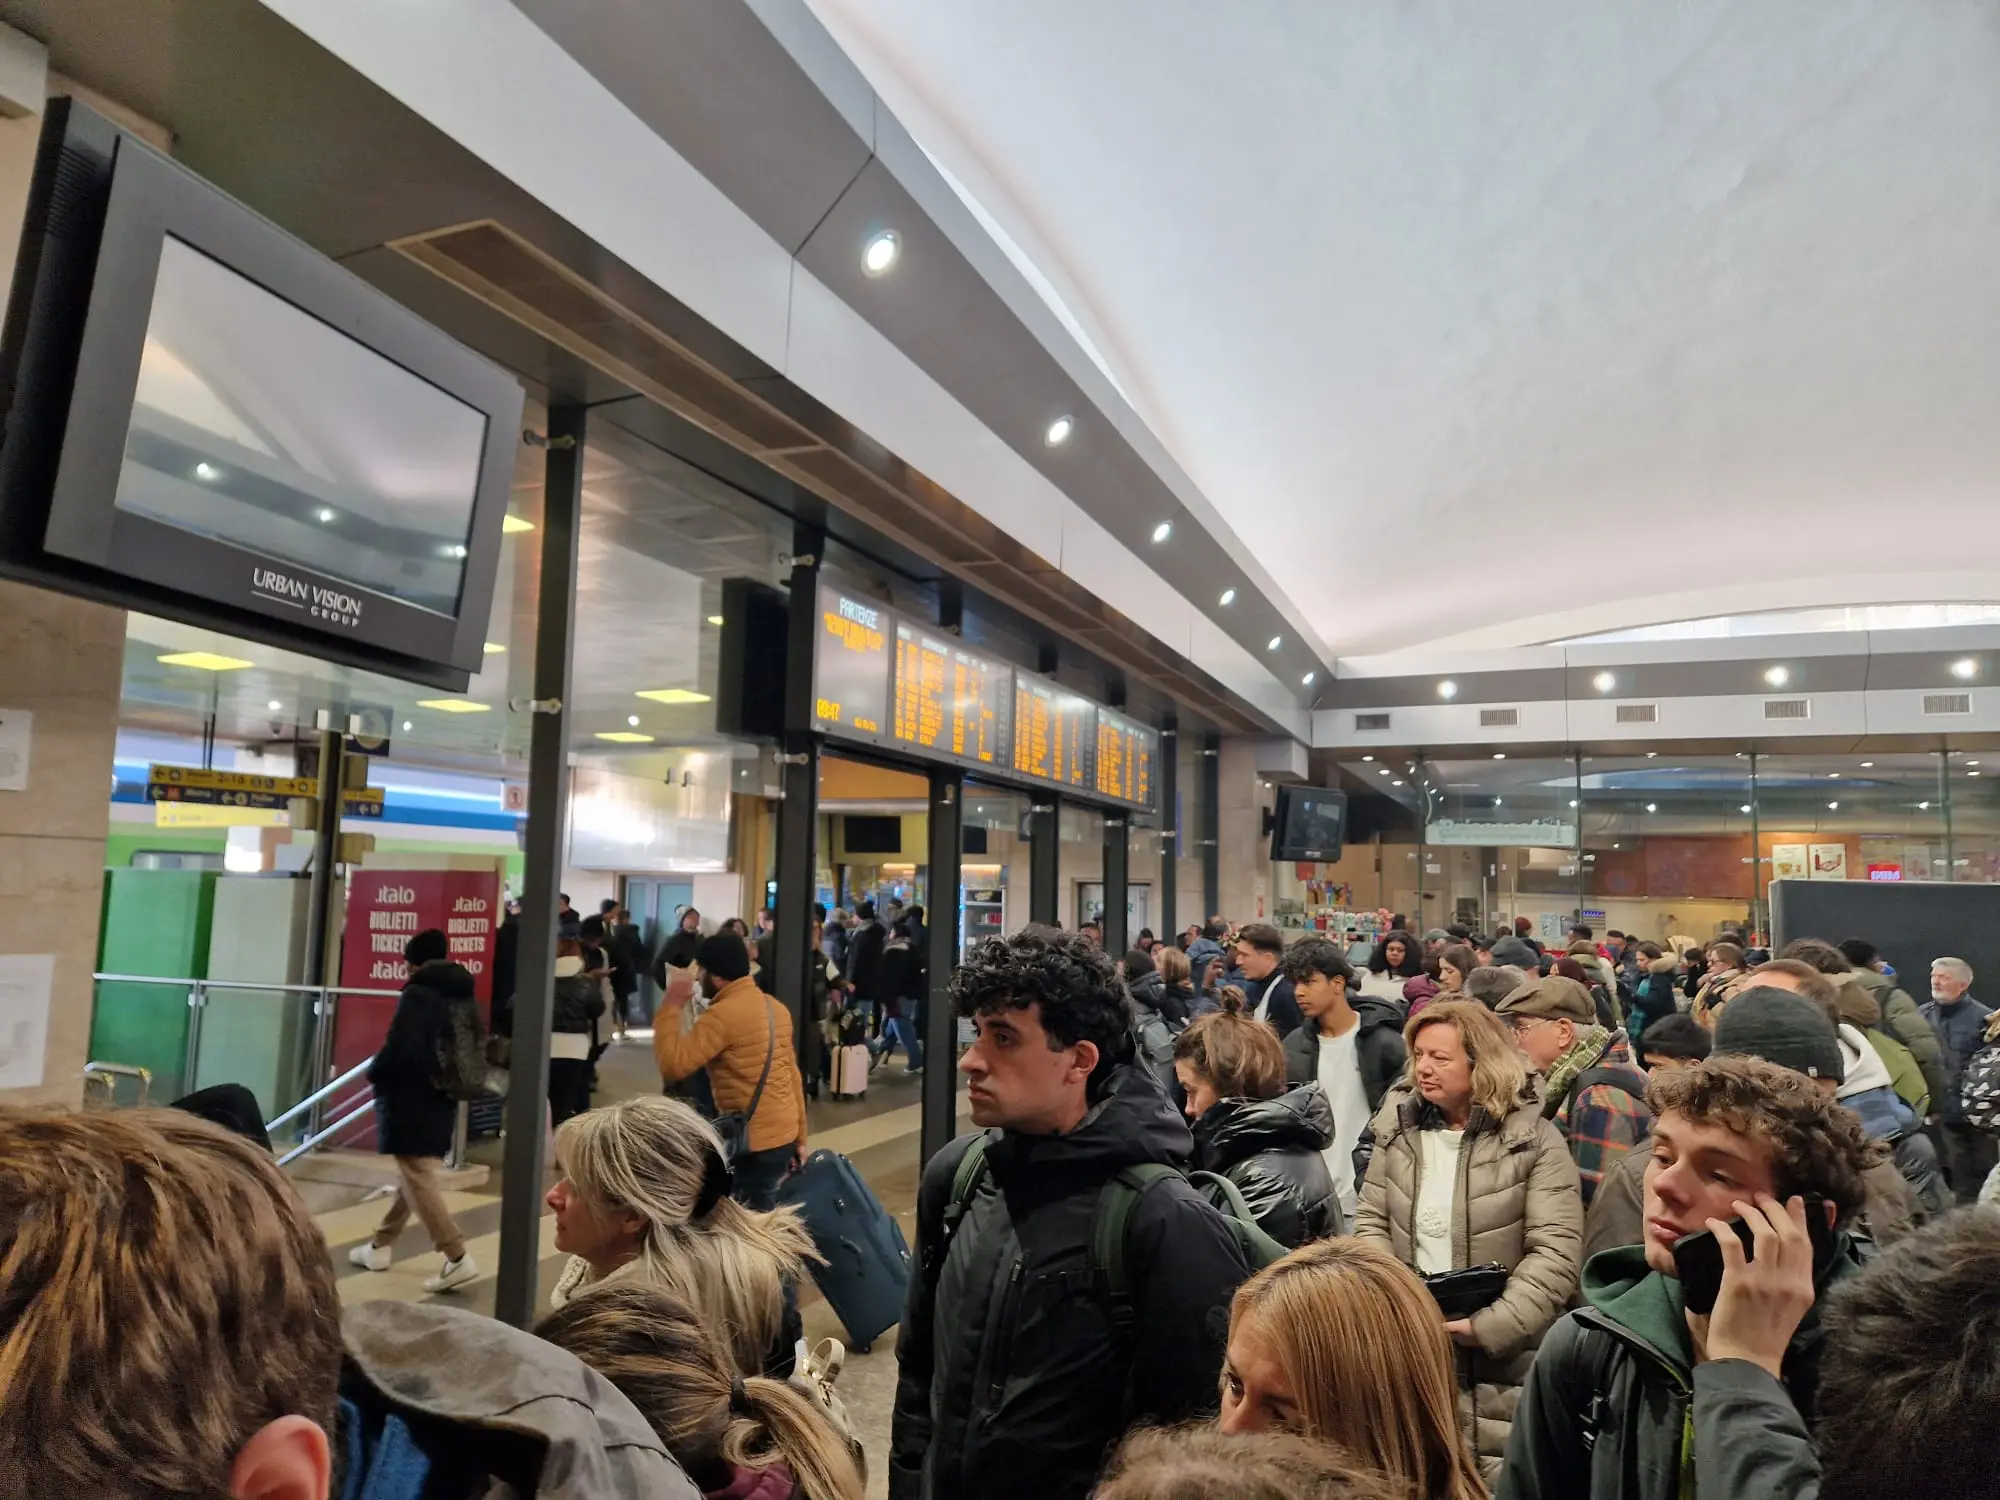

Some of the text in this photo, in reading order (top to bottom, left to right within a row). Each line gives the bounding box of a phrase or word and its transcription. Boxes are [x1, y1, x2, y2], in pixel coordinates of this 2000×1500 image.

[253, 567, 361, 616] URBAN VISION
[310, 605, 359, 627] GROUP
[369, 910, 418, 930] BIGLIETTI
[447, 918, 489, 934] BIGLIETTI
[449, 937, 485, 953] TICKETS
